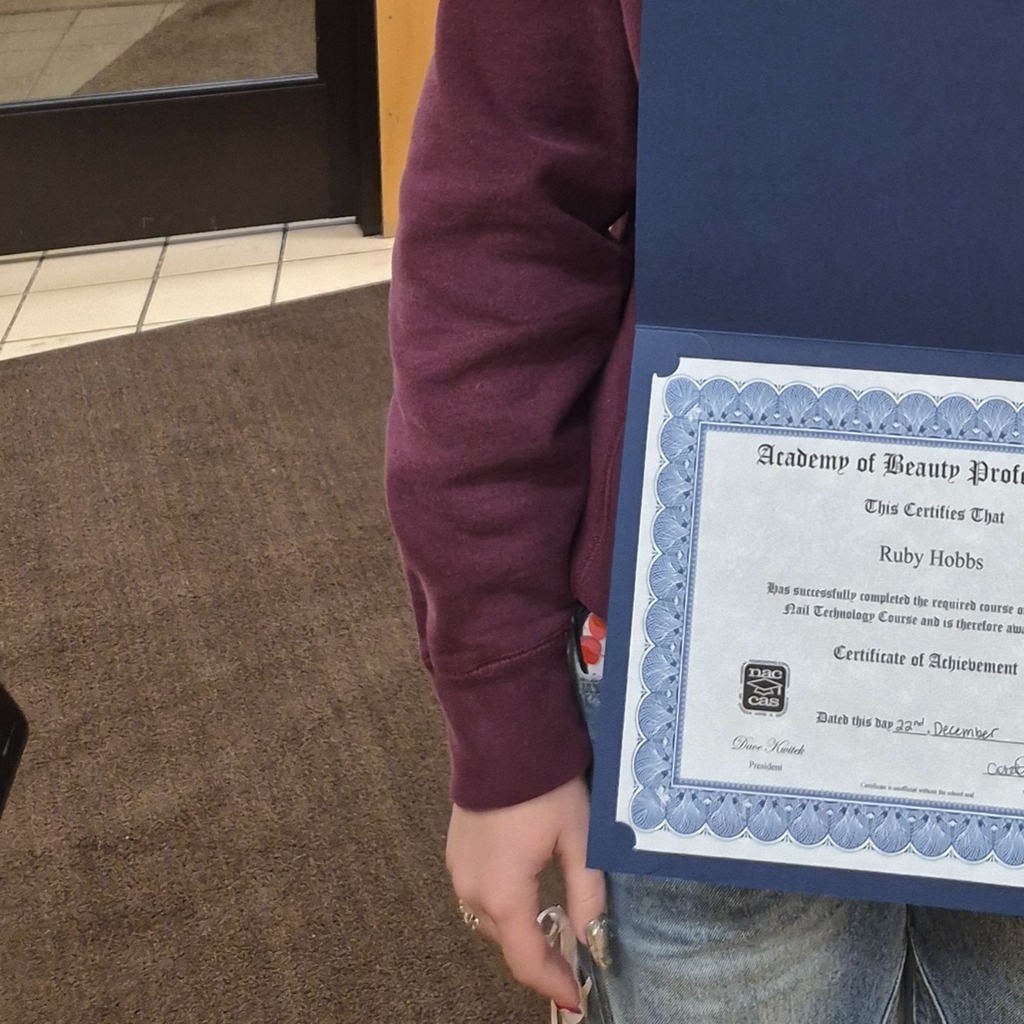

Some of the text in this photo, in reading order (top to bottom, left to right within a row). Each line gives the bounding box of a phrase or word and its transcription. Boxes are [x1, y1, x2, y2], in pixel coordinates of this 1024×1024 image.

[757, 444, 849, 475] Academy
[857, 454, 876, 473] of
[884, 453, 960, 483] Beauty
[864, 498, 1006, 525] This Certifies That
[879, 545, 984, 570] Ruby Hobbs
[767, 582, 790, 596] Has
[793, 585, 857, 602] successfully
[860, 592, 911, 606] completed
[913, 595, 929, 608] the
[932, 597, 976, 611] required
[980, 602, 1014, 615] course
[782, 603, 809, 616] Nail
[813, 605, 875, 624] Technology
[878, 610, 917, 626] Course
[920, 616, 940, 627] and
[943, 617, 953, 628] is
[956, 619, 1003, 632] therefore
[748, 667, 783, 679] nac
[833, 644, 1018, 676] Certificate of Achievement
[748, 696, 780, 707] cas
[816, 711, 849, 725] Dated
[852, 715, 872, 728] this
[875, 717, 893, 731] day
[933, 721, 999, 740] December
[731, 735, 763, 750] Dave
[749, 761, 783, 772] President
